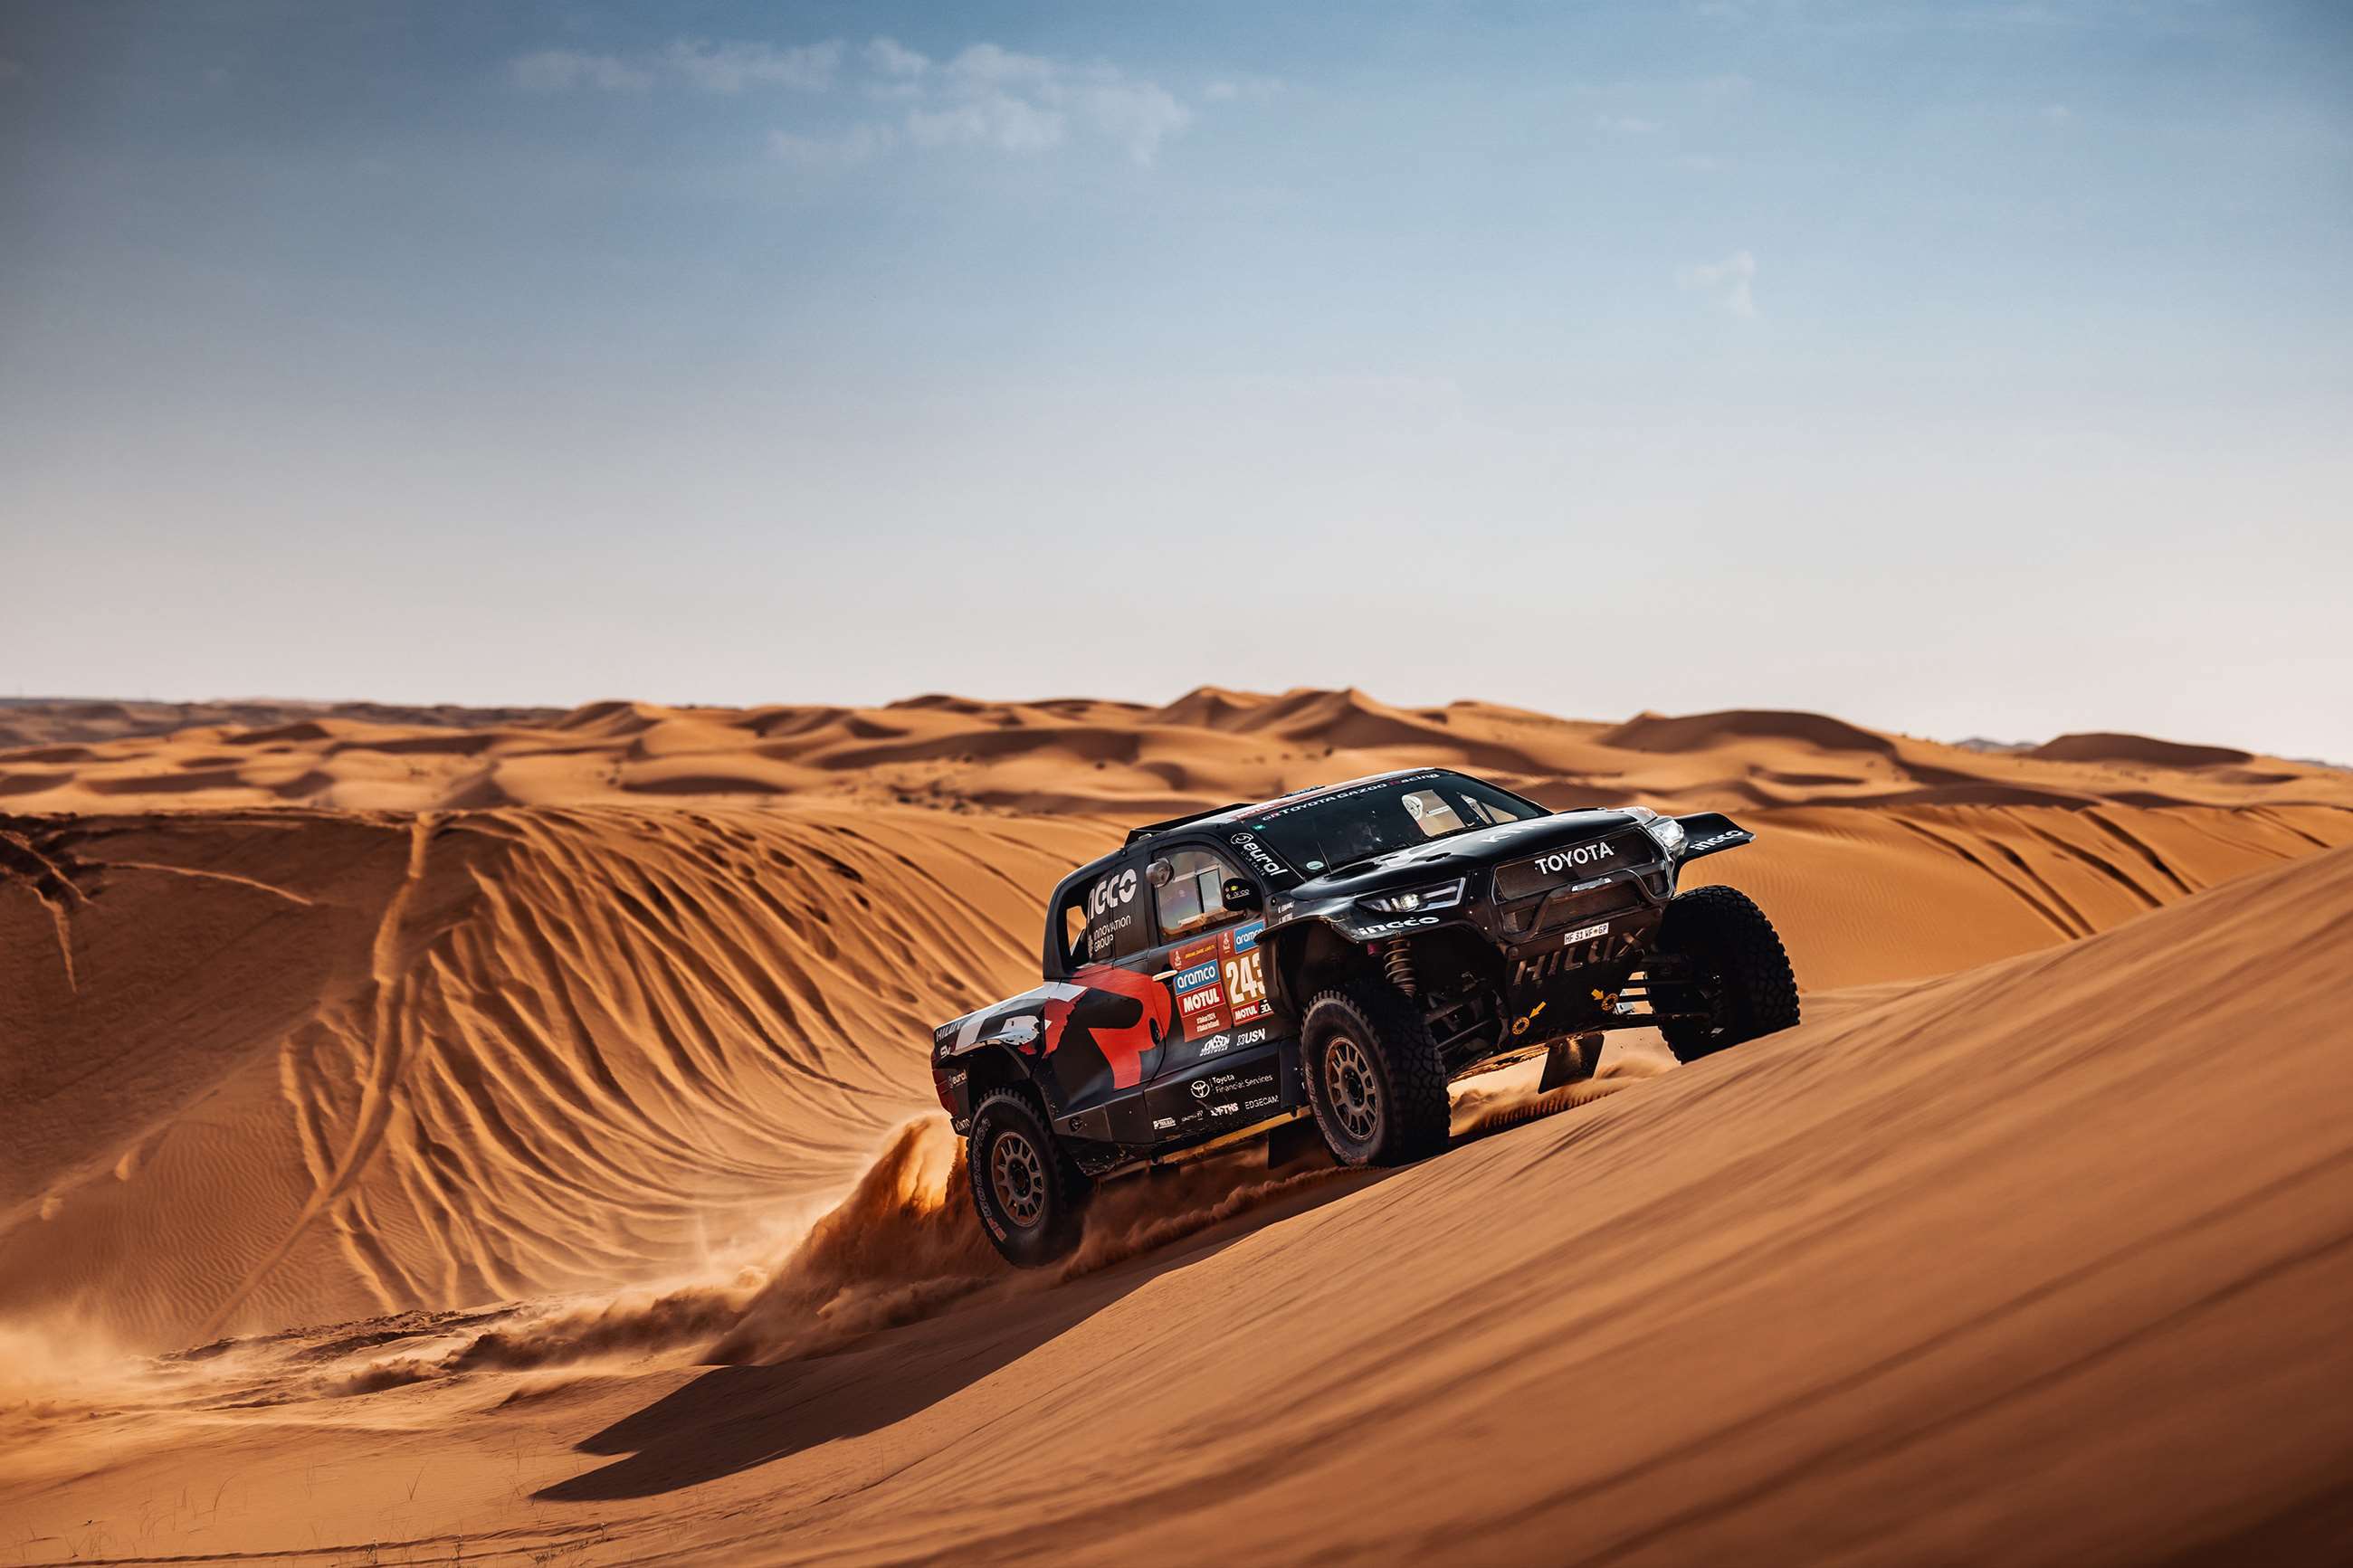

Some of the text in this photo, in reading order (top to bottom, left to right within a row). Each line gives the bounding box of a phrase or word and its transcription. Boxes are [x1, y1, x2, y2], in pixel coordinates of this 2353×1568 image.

[1279, 796, 1337, 815] TOYOTA
[1338, 783, 1387, 799] GAZOO
[1243, 842, 1288, 876] eurol
[1535, 841, 1614, 875] TOYOTA
[1093, 934, 1114, 952] GROUP
[1177, 965, 1216, 989] aramco
[1183, 988, 1220, 1013] MOTUL
[1234, 1005, 1257, 1021] MOTUL
[1244, 1028, 1266, 1044] USN
[1212, 1074, 1235, 1085] Toyota
[1215, 1074, 1273, 1094] Financial Services
[1244, 1095, 1280, 1109] EDGECAM
